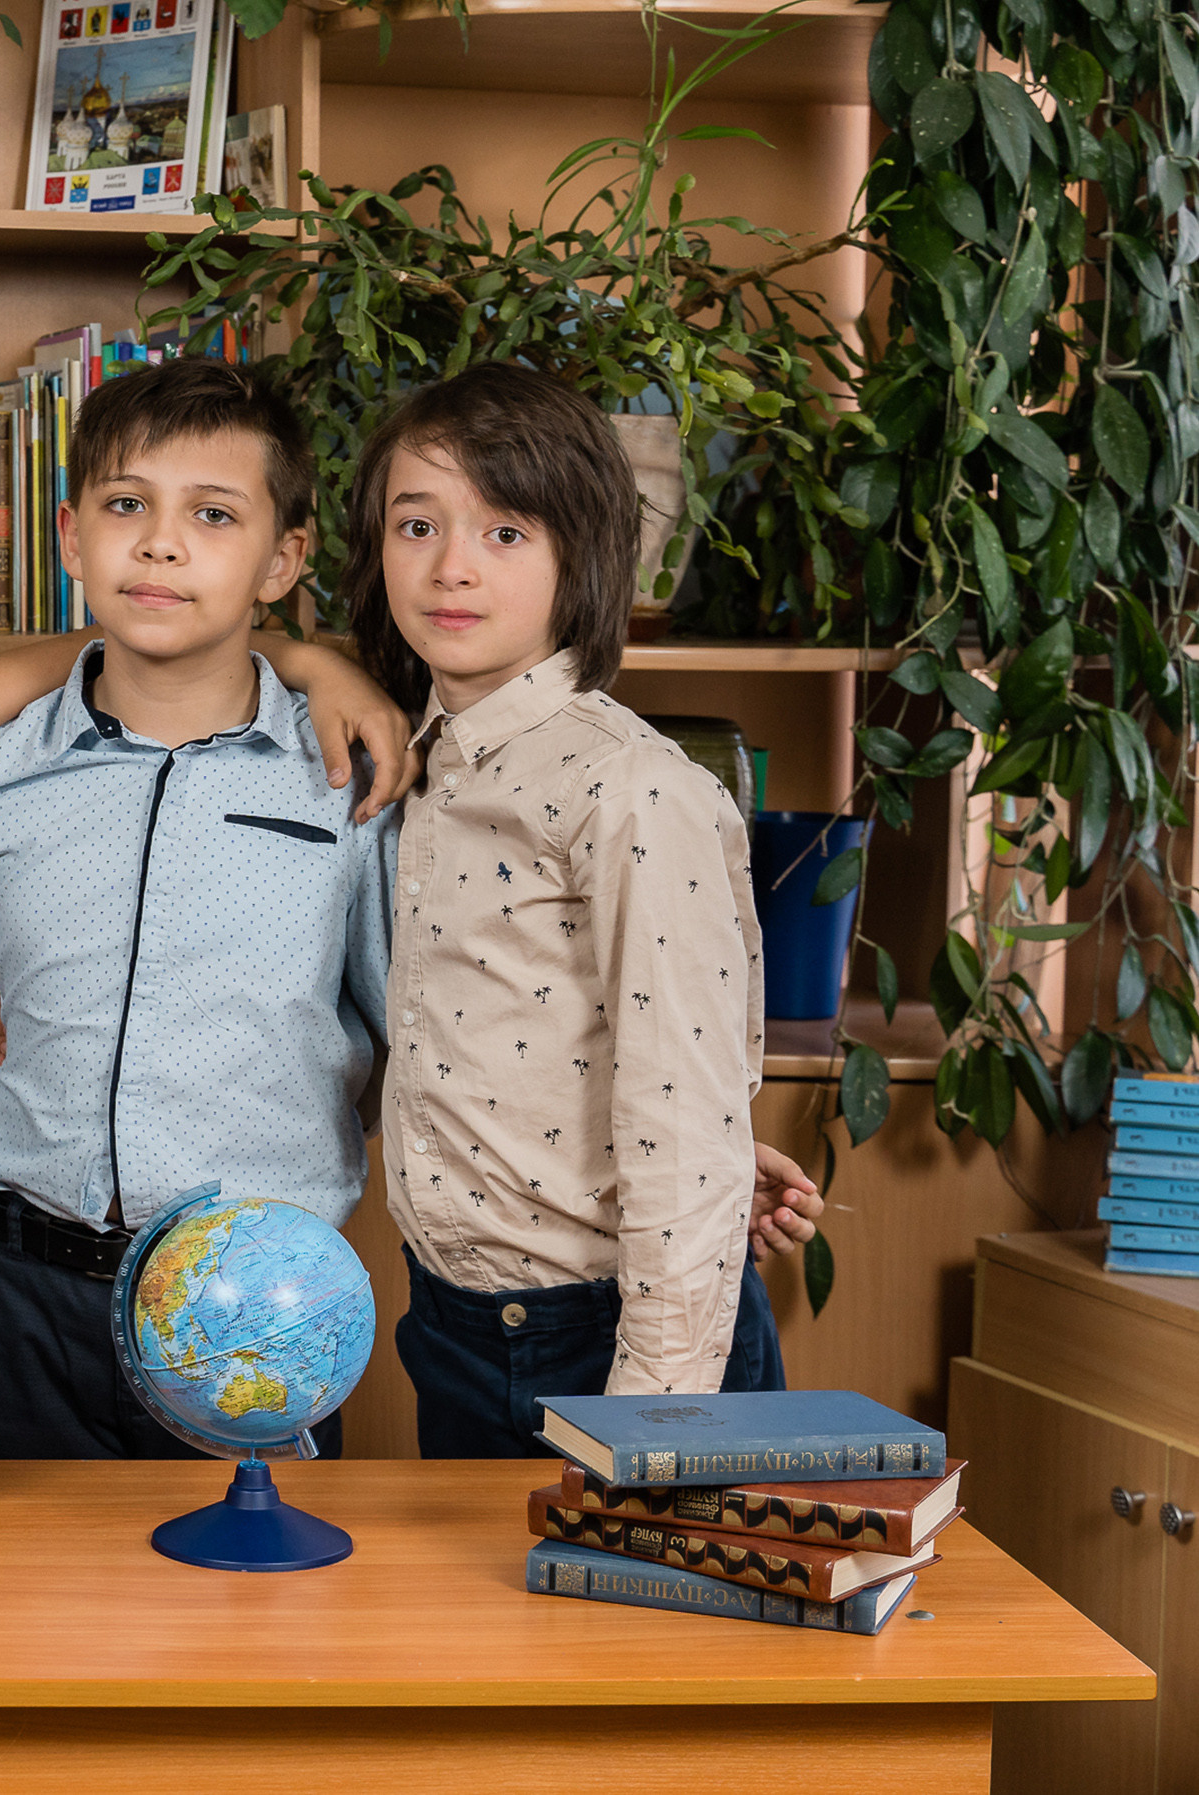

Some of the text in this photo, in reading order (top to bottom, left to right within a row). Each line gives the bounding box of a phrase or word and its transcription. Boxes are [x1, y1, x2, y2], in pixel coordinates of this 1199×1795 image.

[683, 1447, 791, 1474] ПУШКИН
[677, 1487, 719, 1504] КУПЕР
[630, 1527, 663, 1543] КУПЕР
[592, 1572, 704, 1604] ПУШКИН
